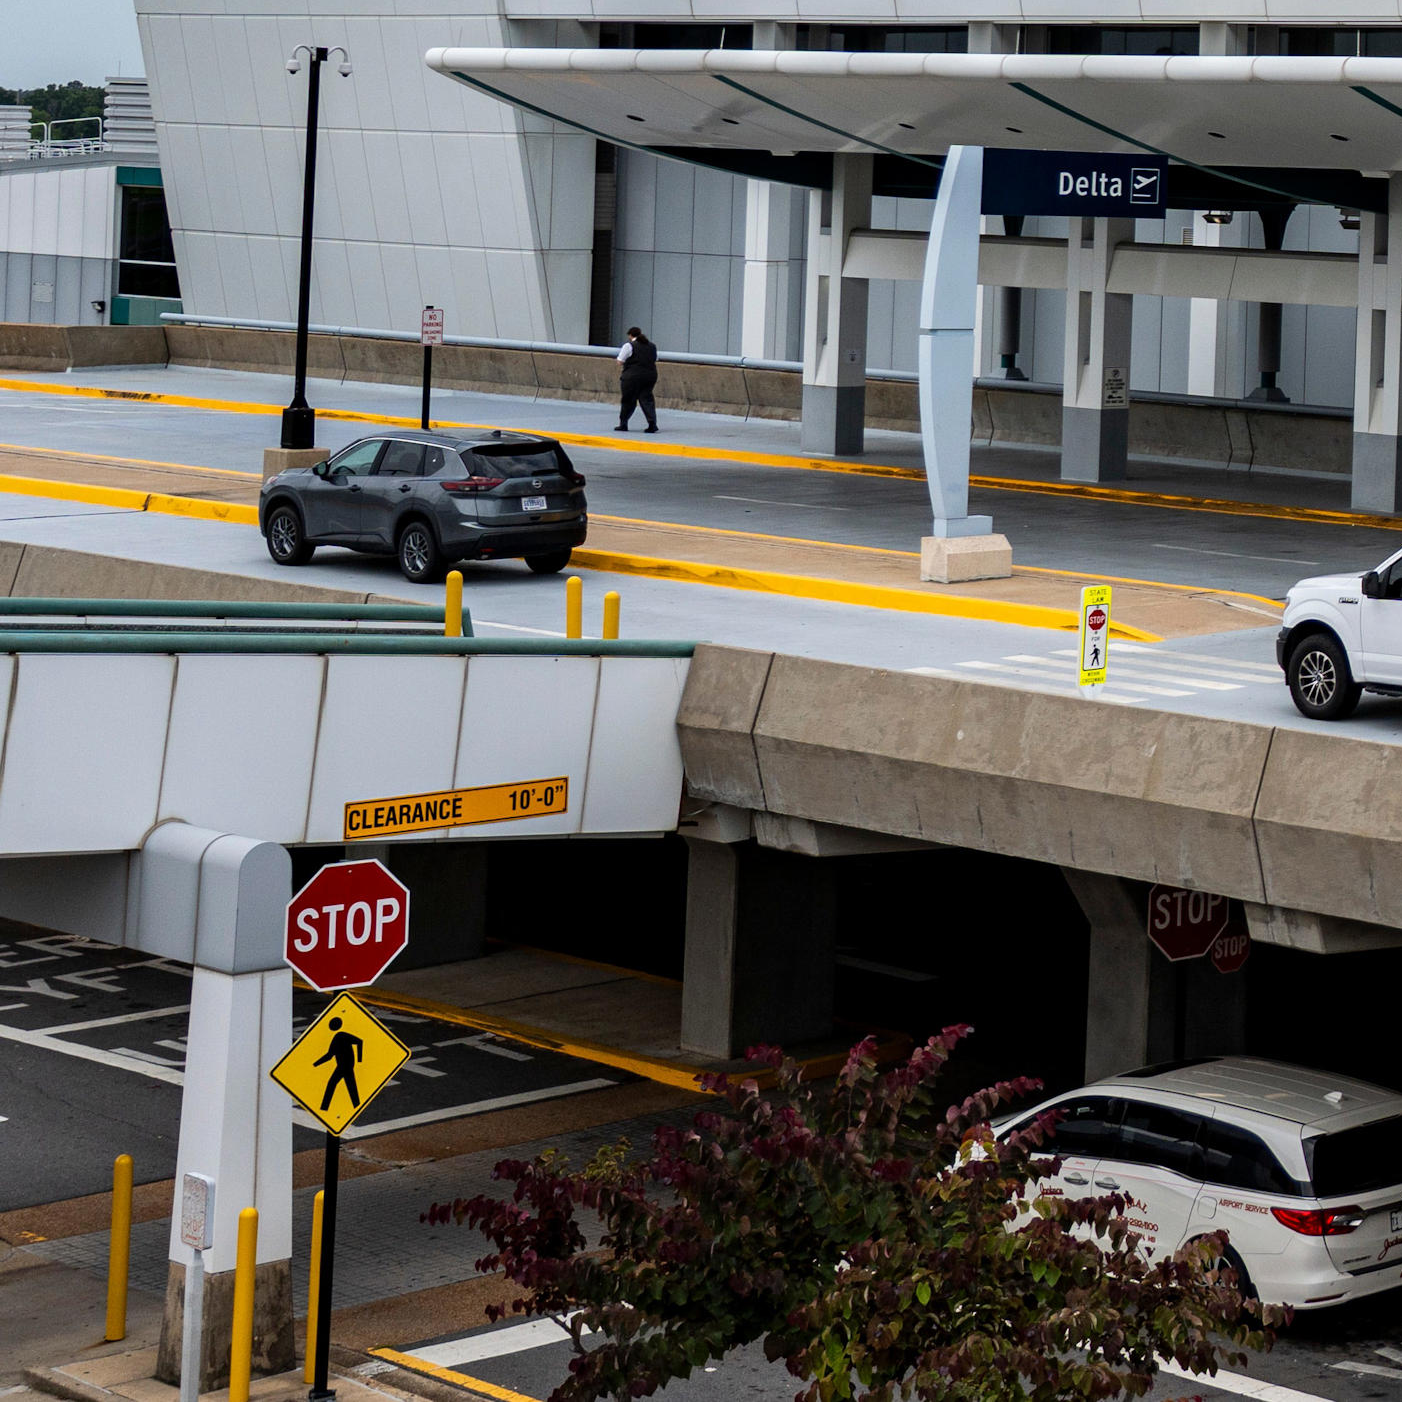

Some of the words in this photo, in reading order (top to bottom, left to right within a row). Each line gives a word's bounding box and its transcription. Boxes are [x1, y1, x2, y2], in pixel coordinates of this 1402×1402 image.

[1059, 171, 1122, 197] Delta
[1089, 615, 1106, 625] STOP
[348, 798, 463, 831] CLEARANCE
[1155, 891, 1222, 929] STOP
[294, 897, 400, 953] STOP
[1215, 935, 1247, 959] STOP
[1219, 1198, 1243, 1209] AIRPORT
[1244, 1204, 1268, 1214] SERVICE
